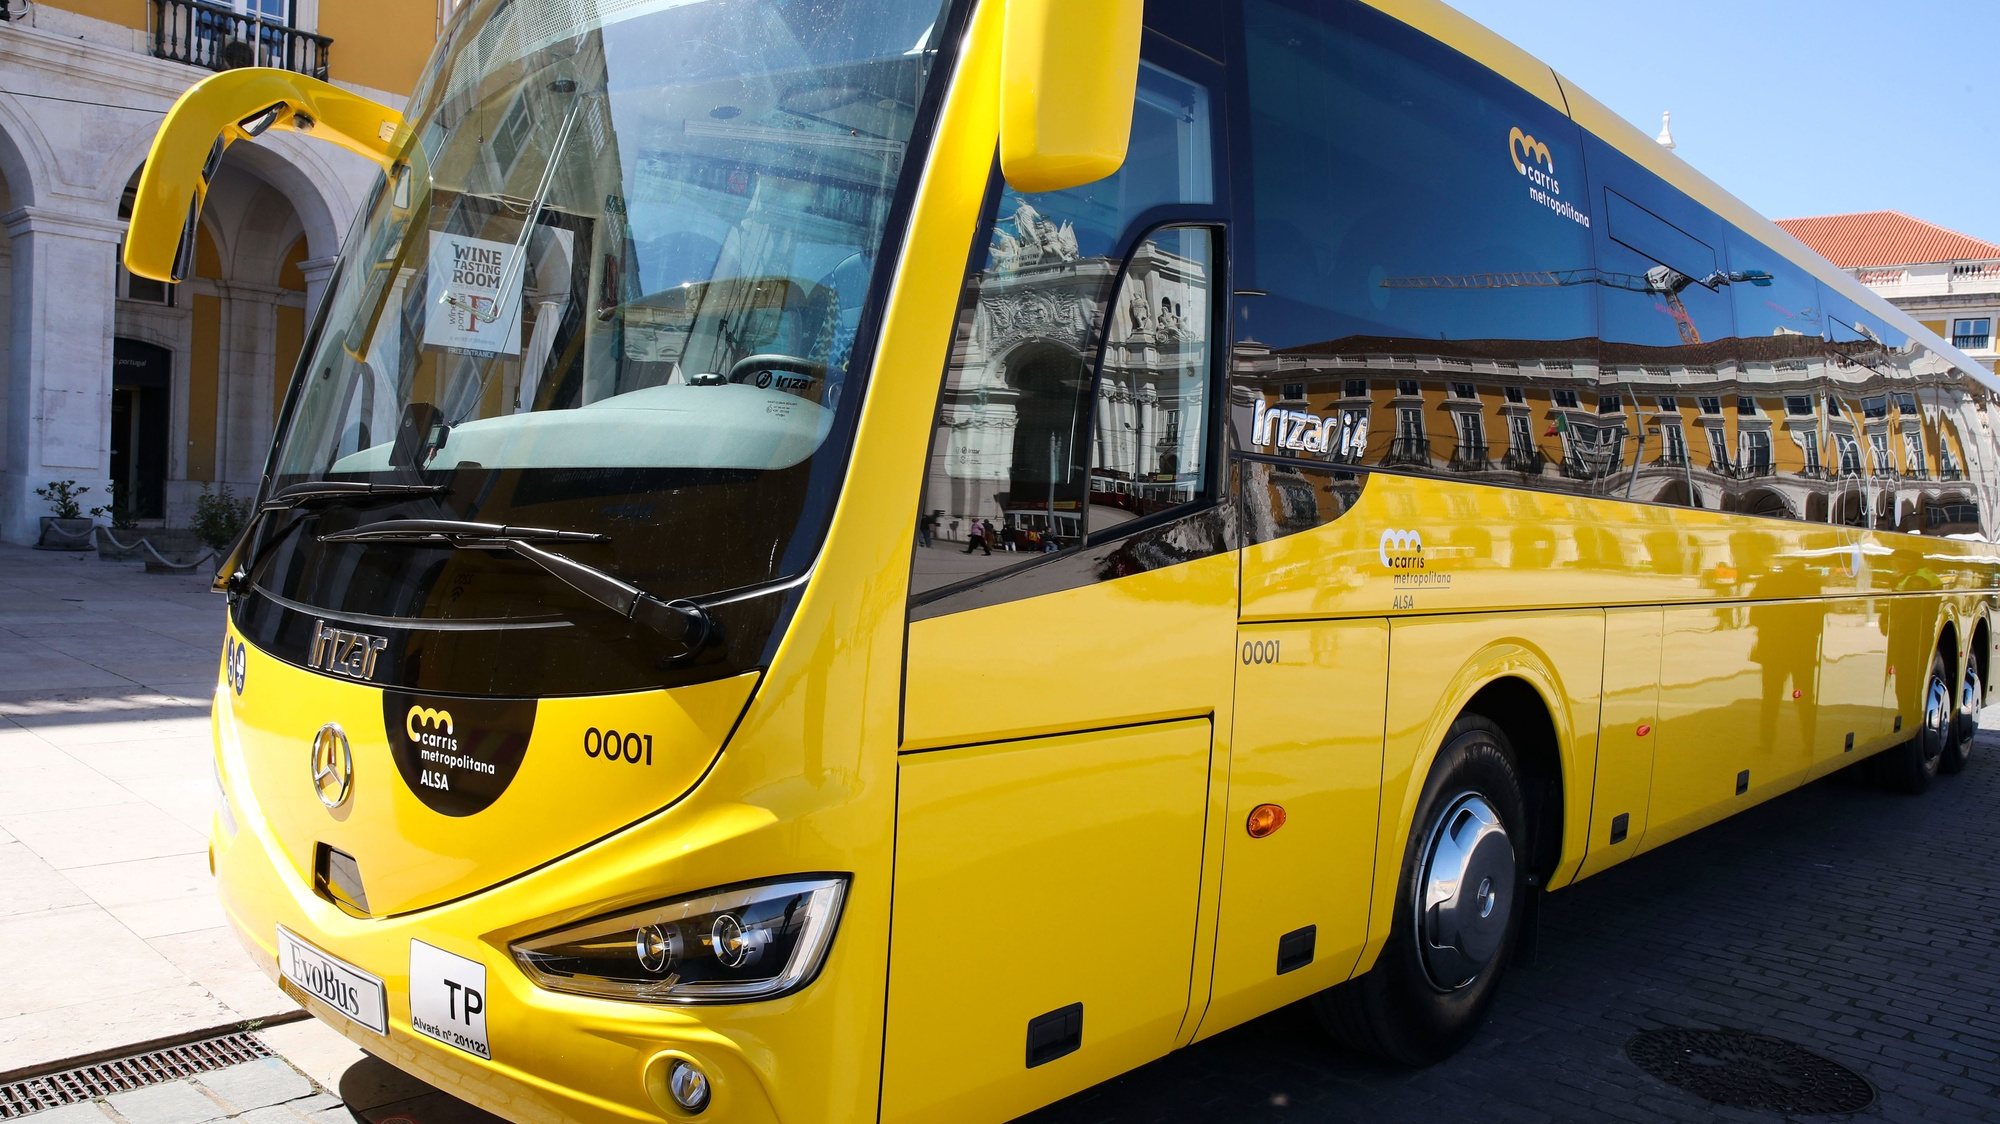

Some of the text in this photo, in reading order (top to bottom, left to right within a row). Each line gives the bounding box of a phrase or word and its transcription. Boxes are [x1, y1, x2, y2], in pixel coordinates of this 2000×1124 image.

[1527, 166, 1560, 195] carris
[1529, 186, 1589, 228] metropolitana
[451, 241, 502, 266] WINE
[452, 269, 501, 289] ROOM
[453, 259, 501, 276] TASTING
[775, 375, 817, 390] Irizar
[1252, 399, 1368, 458] Irizar i4
[1394, 555, 1425, 569] carris
[1393, 571, 1451, 587] metropolitana
[1392, 594, 1414, 610] ALSA
[307, 619, 389, 680] Irizar
[1242, 640, 1281, 666] 0001
[421, 731, 458, 751] carris
[584, 726, 653, 766] 0001
[421, 749, 496, 775] metropolitana
[420, 769, 449, 791] ALSA
[289, 941, 360, 1016] EvoBus
[444, 978, 483, 1026] TP
[413, 1015, 441, 1037] Alvará
[454, 1032, 488, 1055] 201122
